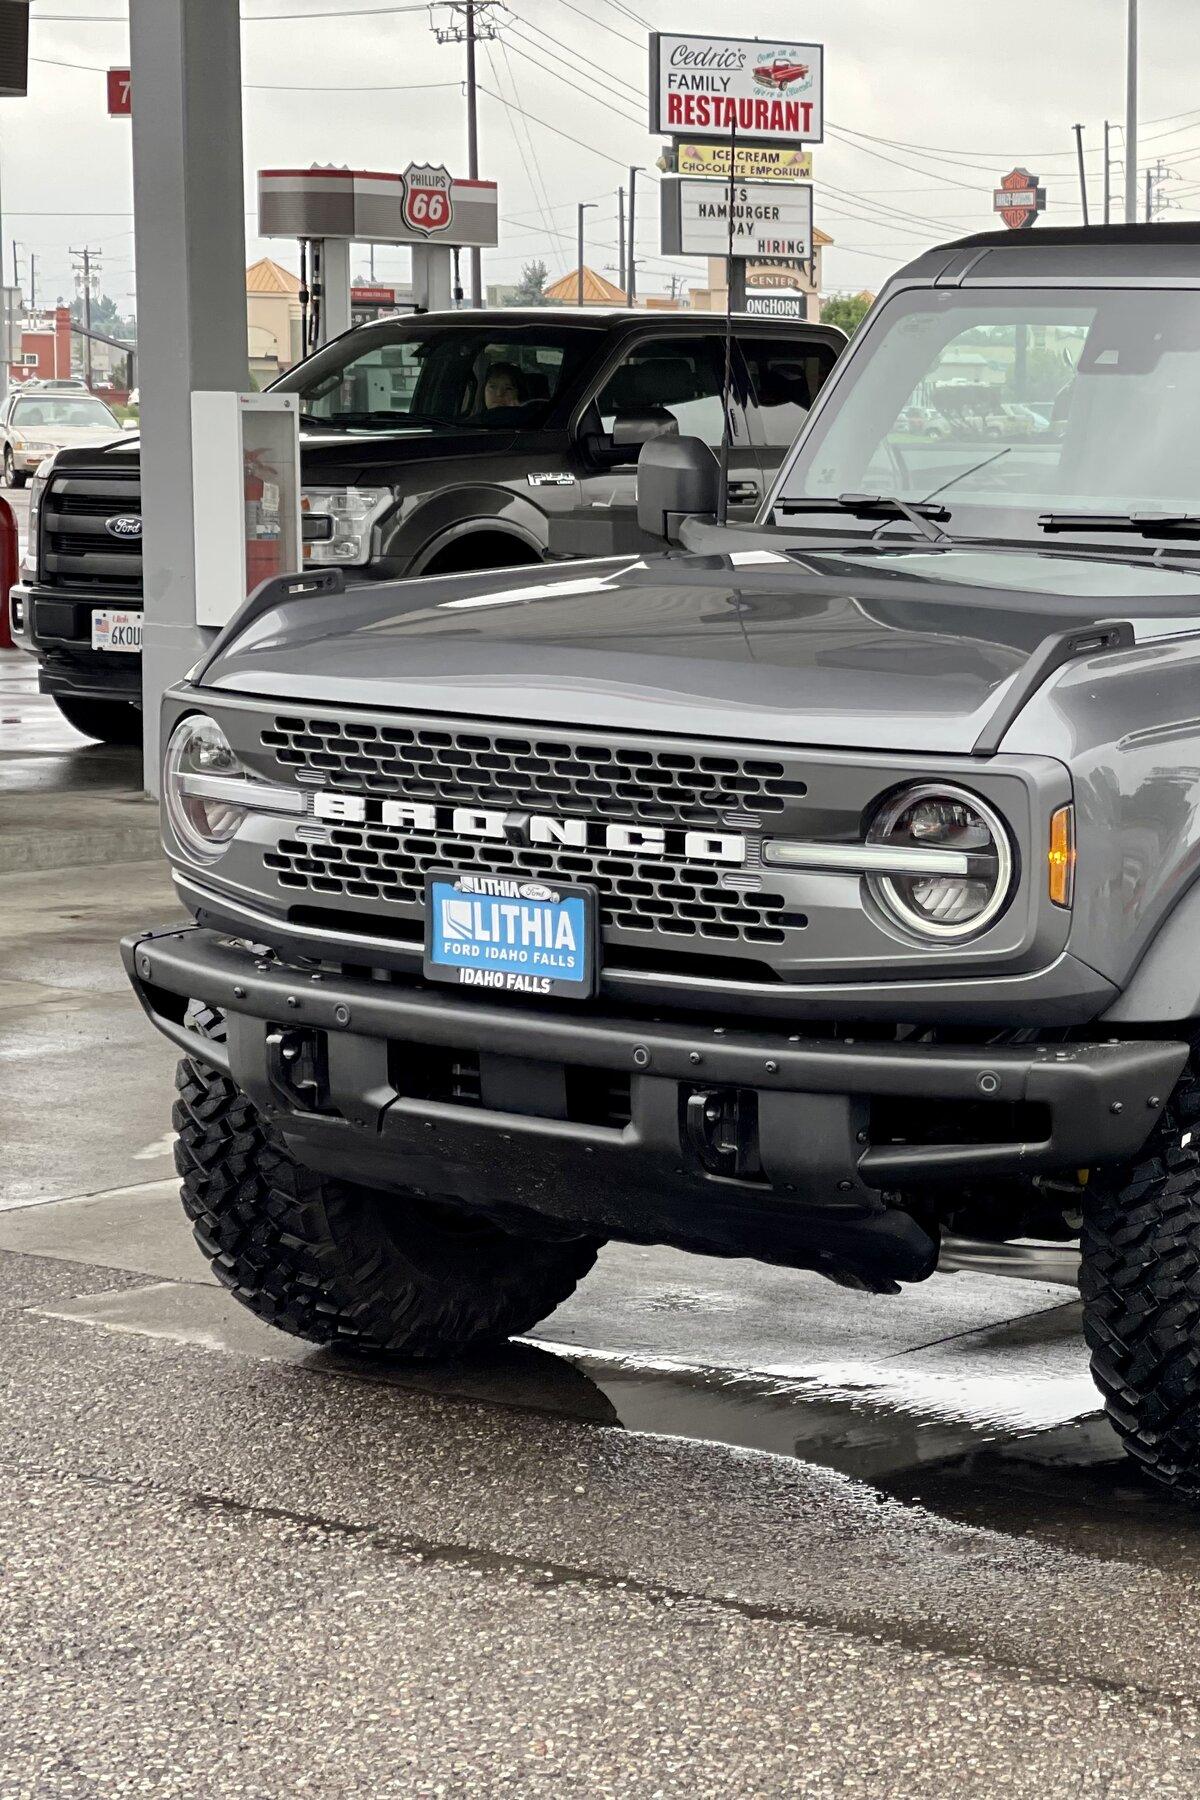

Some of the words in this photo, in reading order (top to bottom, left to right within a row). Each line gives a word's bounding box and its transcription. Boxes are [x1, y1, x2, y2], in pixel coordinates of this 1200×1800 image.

[670, 44, 746, 69] Cedric's
[668, 73, 731, 92] FAMILY
[119, 81, 131, 104] 7
[668, 93, 814, 133] RESTAURANT
[712, 149, 730, 161] ICE
[737, 151, 780, 163] CREAM
[682, 161, 745, 174] CHOCOLATE
[750, 165, 810, 176] EMPORIUM
[410, 173, 446, 188] PHILLIPS
[413, 193, 444, 220] 66
[698, 204, 780, 220] HAMBURGER
[728, 222, 754, 235] DAY
[758, 240, 804, 254] HIRING
[750, 275, 794, 286] CENTER
[746, 299, 800, 315] ONGHORN
[114, 518, 141, 533] Ford
[111, 626, 143, 645] 6K0U
[313, 791, 747, 863] BRONCO
[474, 877, 521, 899] LITHIA
[526, 886, 545, 898] Ford
[473, 902, 576, 952] LITHIA
[444, 942, 480, 957] FORD
[485, 947, 528, 962] IDAHO
[533, 952, 575, 968] FALLS
[459, 968, 504, 988] IDAHO
[507, 974, 551, 994] FALLS
